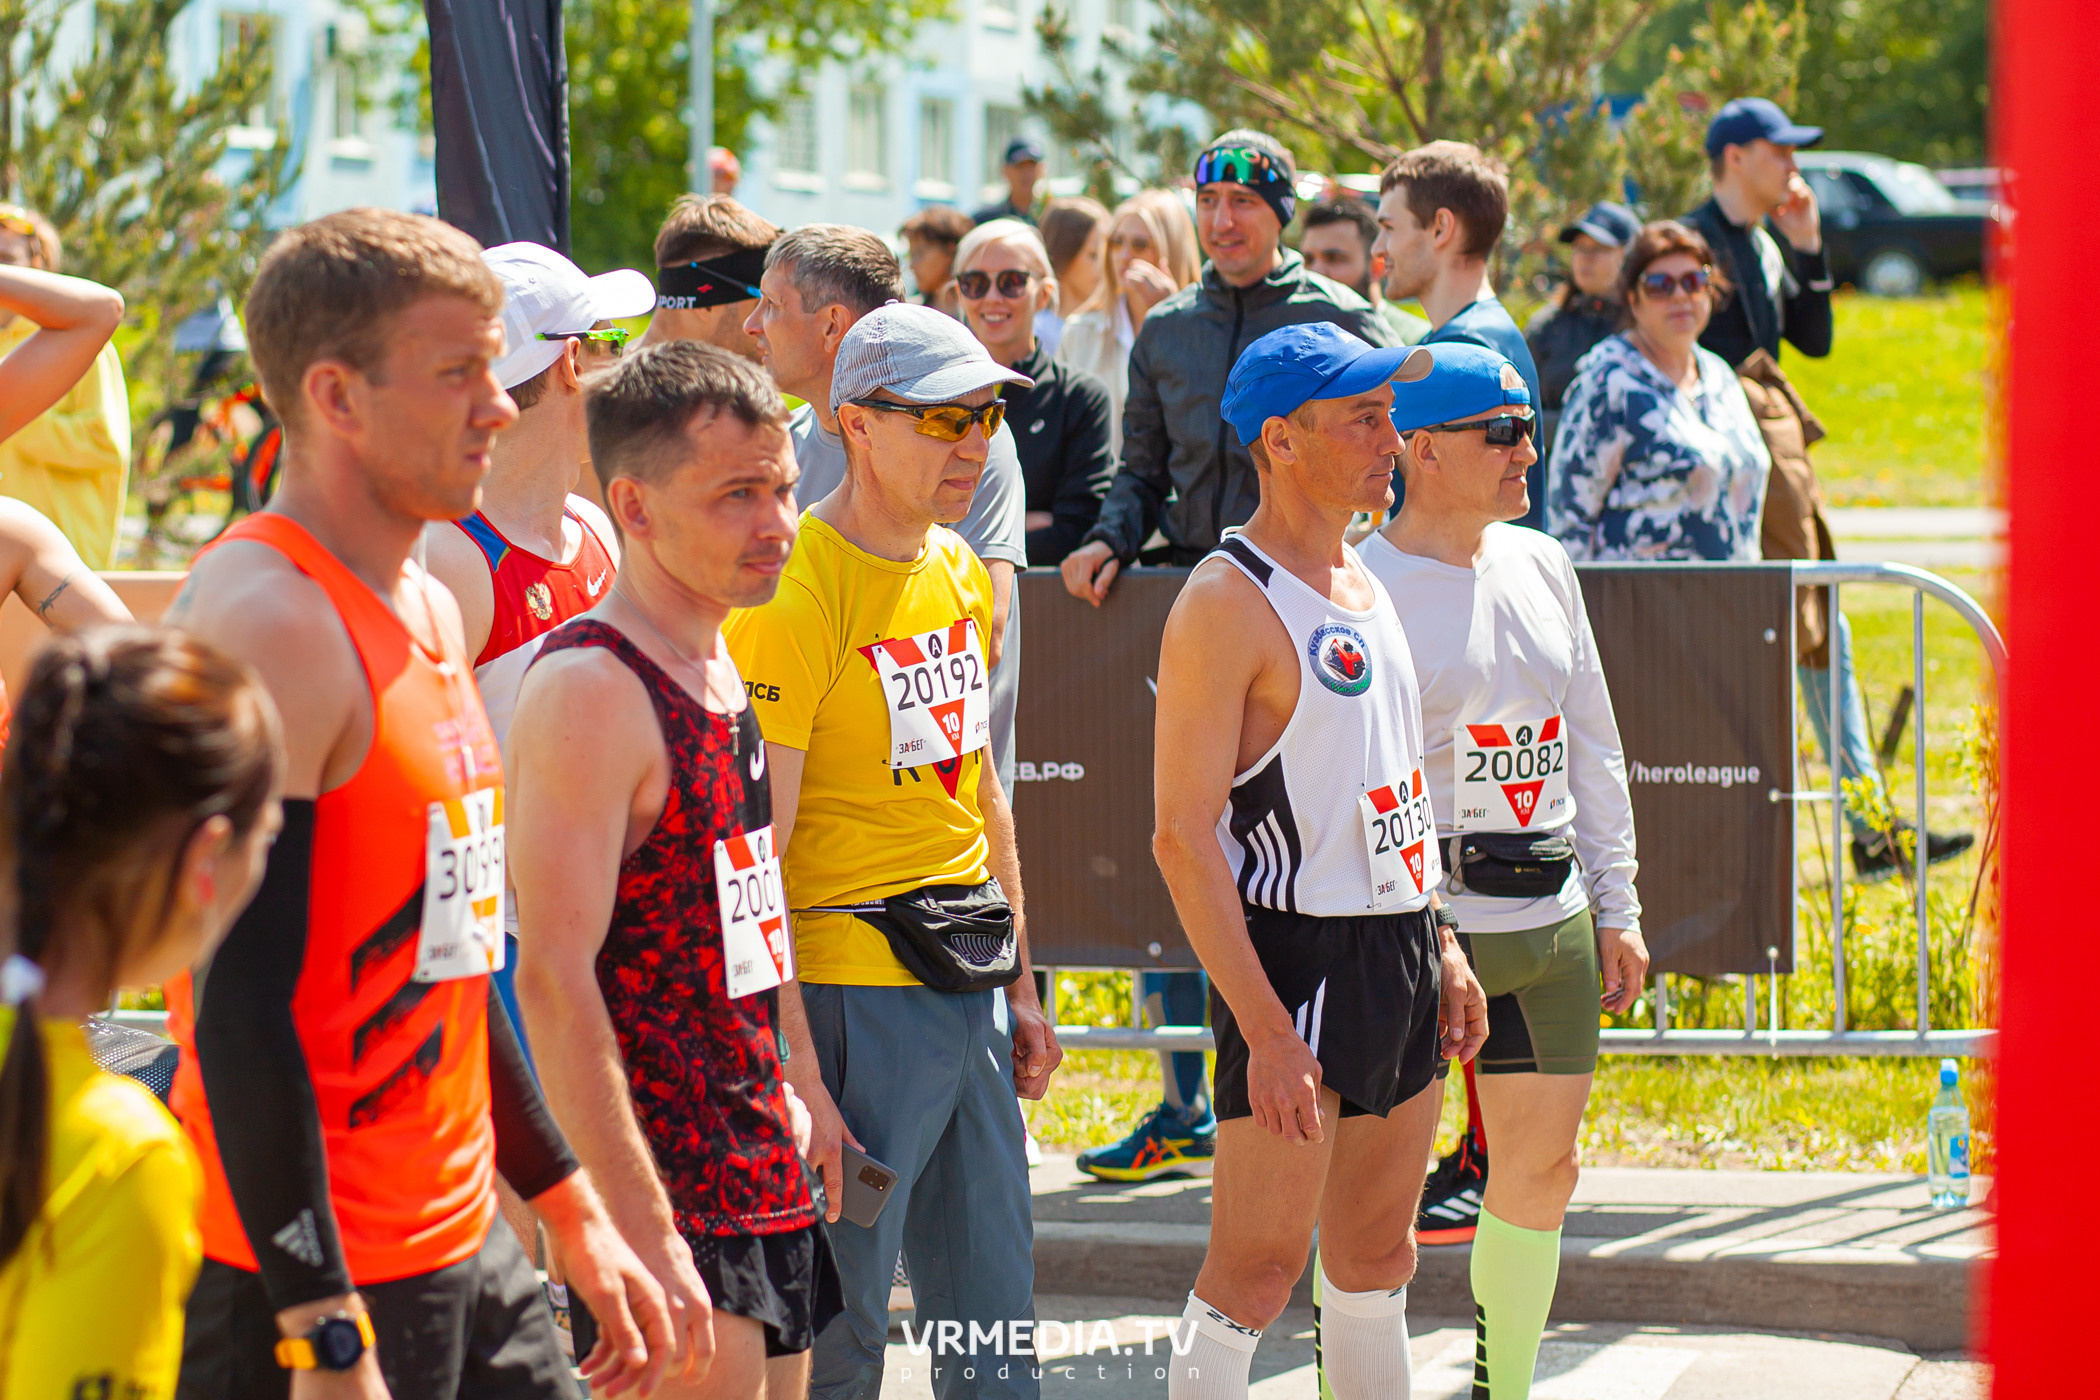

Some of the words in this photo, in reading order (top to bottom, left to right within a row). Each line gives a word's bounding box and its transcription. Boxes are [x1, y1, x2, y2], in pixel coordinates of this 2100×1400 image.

[891, 653, 983, 711] 20192
[941, 711, 961, 734] 10
[1465, 741, 1563, 782] 20082
[1628, 760, 1761, 788] /heroleague
[1514, 790, 1534, 809] 10
[1372, 796, 1432, 855] 20130
[1409, 852, 1422, 874] 10
